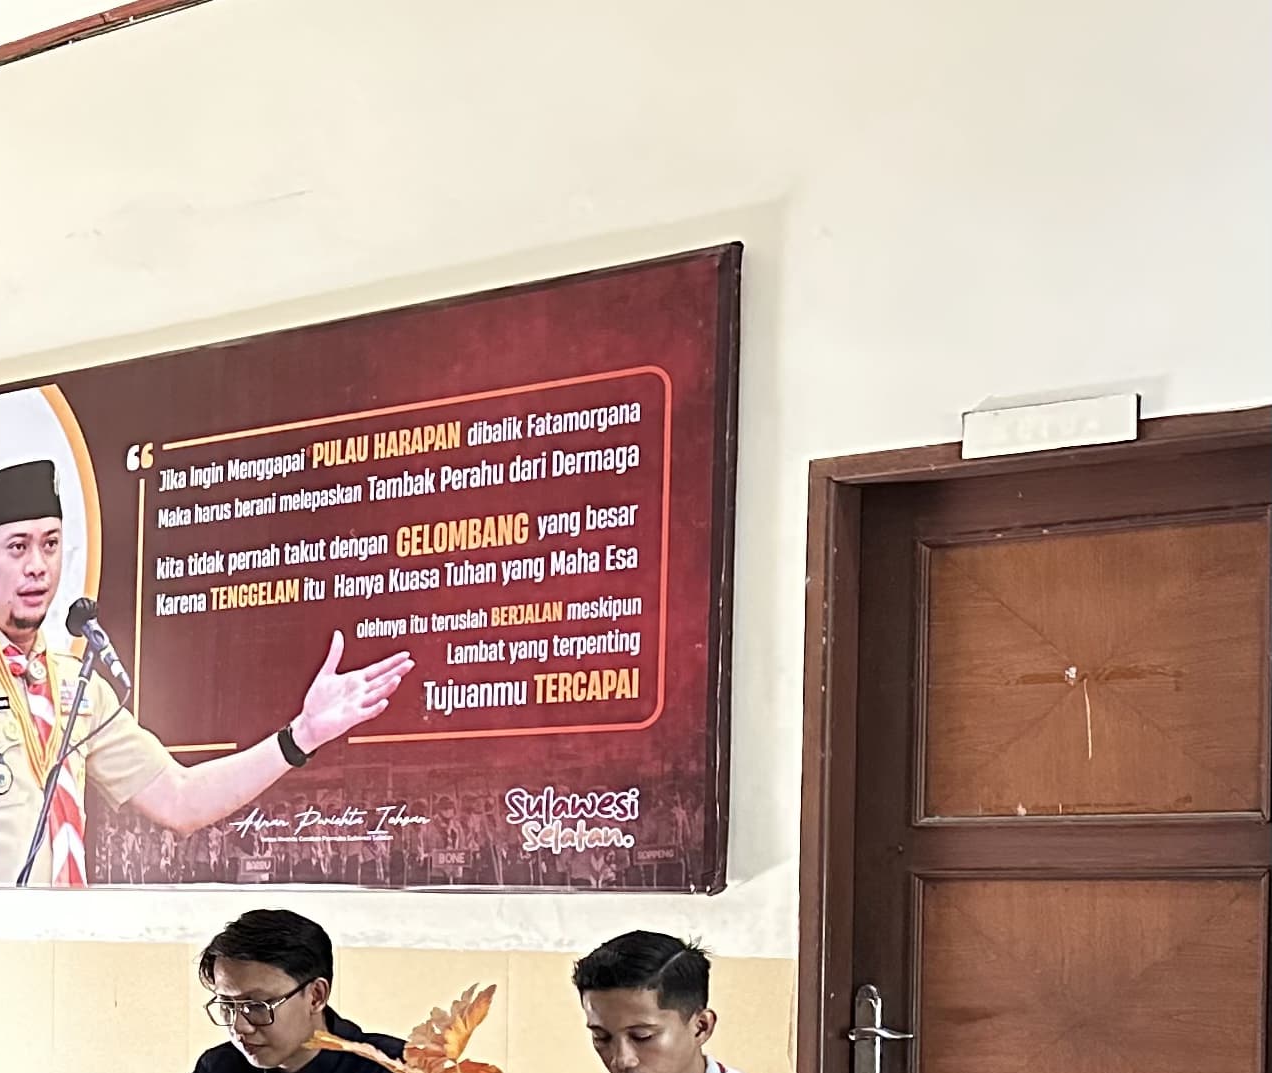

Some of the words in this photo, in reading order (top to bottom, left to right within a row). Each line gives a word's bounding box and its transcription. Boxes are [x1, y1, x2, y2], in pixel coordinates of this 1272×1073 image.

[159, 468, 186, 492] Jika
[190, 464, 223, 489] Ingin
[228, 448, 305, 482] Menggapai
[312, 435, 369, 469] PULAU
[374, 421, 461, 460] HARAPAN
[467, 416, 522, 446] dibalik
[528, 402, 641, 436] Fatamorgana
[158, 508, 191, 528] Maka
[194, 503, 231, 524] harus
[235, 493, 276, 519] berani
[279, 484, 362, 512] melepaskan
[367, 470, 435, 502] Tambak
[440, 460, 504, 492] Perahu
[509, 452, 547, 483] dari
[552, 444, 640, 478] Dermaga
[156, 557, 184, 580] kita
[187, 551, 224, 575] tidak
[228, 544, 280, 576] pernah
[284, 539, 326, 564] takut
[329, 534, 388, 560] dengan
[396, 512, 529, 557] GELOMBANG
[537, 511, 580, 540] yang
[585, 504, 638, 531] besar
[156, 593, 206, 617] Karena
[210, 578, 300, 611] TENGGELAM
[303, 577, 325, 601] itu
[334, 573, 384, 600] Hanya
[388, 567, 439, 593] Kuasa
[444, 561, 496, 587] Tuhan
[501, 556, 545, 586] yang
[550, 550, 600, 577] Maha
[605, 544, 638, 570] Esa
[357, 617, 406, 639] olehnya
[409, 615, 428, 634] itu
[431, 608, 487, 632] teruslah
[491, 601, 563, 627] BERJALAN
[567, 596, 642, 621] meskipun
[447, 639, 505, 665] Lambat
[508, 638, 548, 664] yang
[553, 630, 641, 659] terpenting
[423, 679, 527, 715] Tujuanmu
[534, 668, 639, 704] TERCAPAI
[506, 787, 639, 824] Sulawesi
